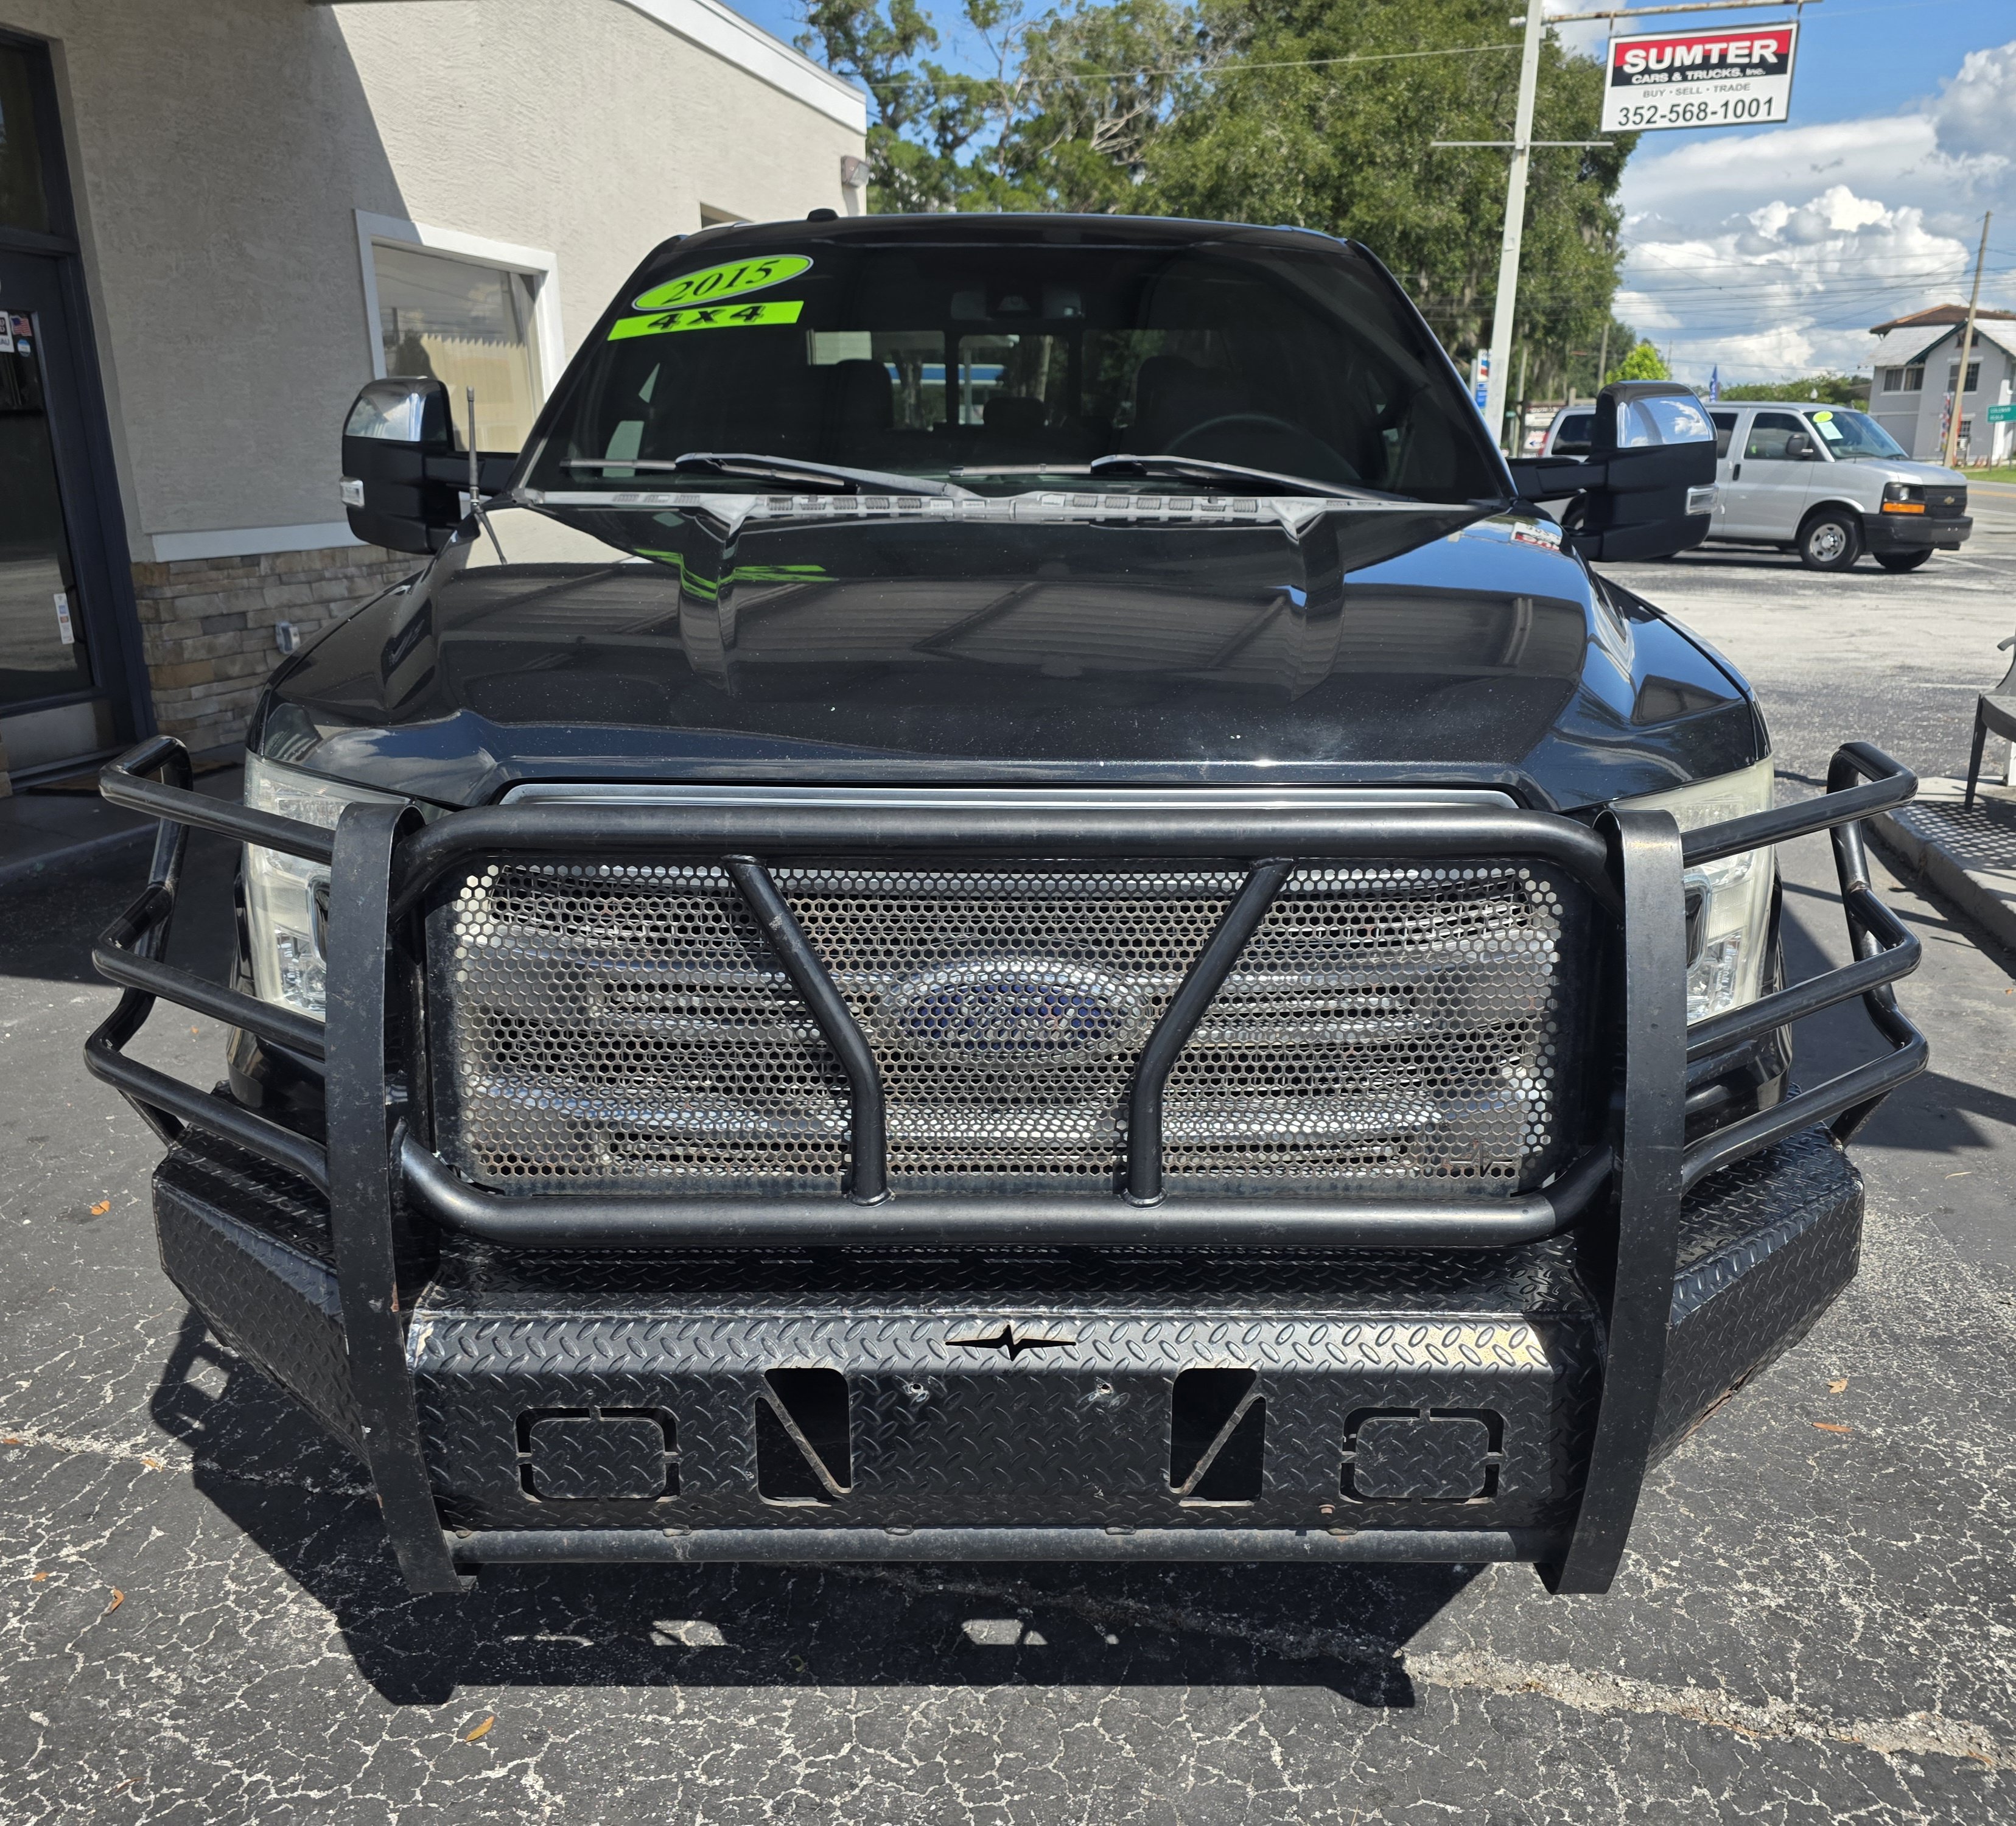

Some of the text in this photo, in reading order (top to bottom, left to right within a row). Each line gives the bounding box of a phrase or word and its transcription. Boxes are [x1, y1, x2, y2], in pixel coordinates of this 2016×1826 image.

[1623, 39, 1778, 73] SUMTER
[1632, 73, 1669, 84] CARS
[1672, 72, 1682, 81] &
[1643, 83, 1751, 98] BUY SELL TRADE
[1618, 96, 1774, 126] 352-568-1001
[661, 260, 780, 305] 2015
